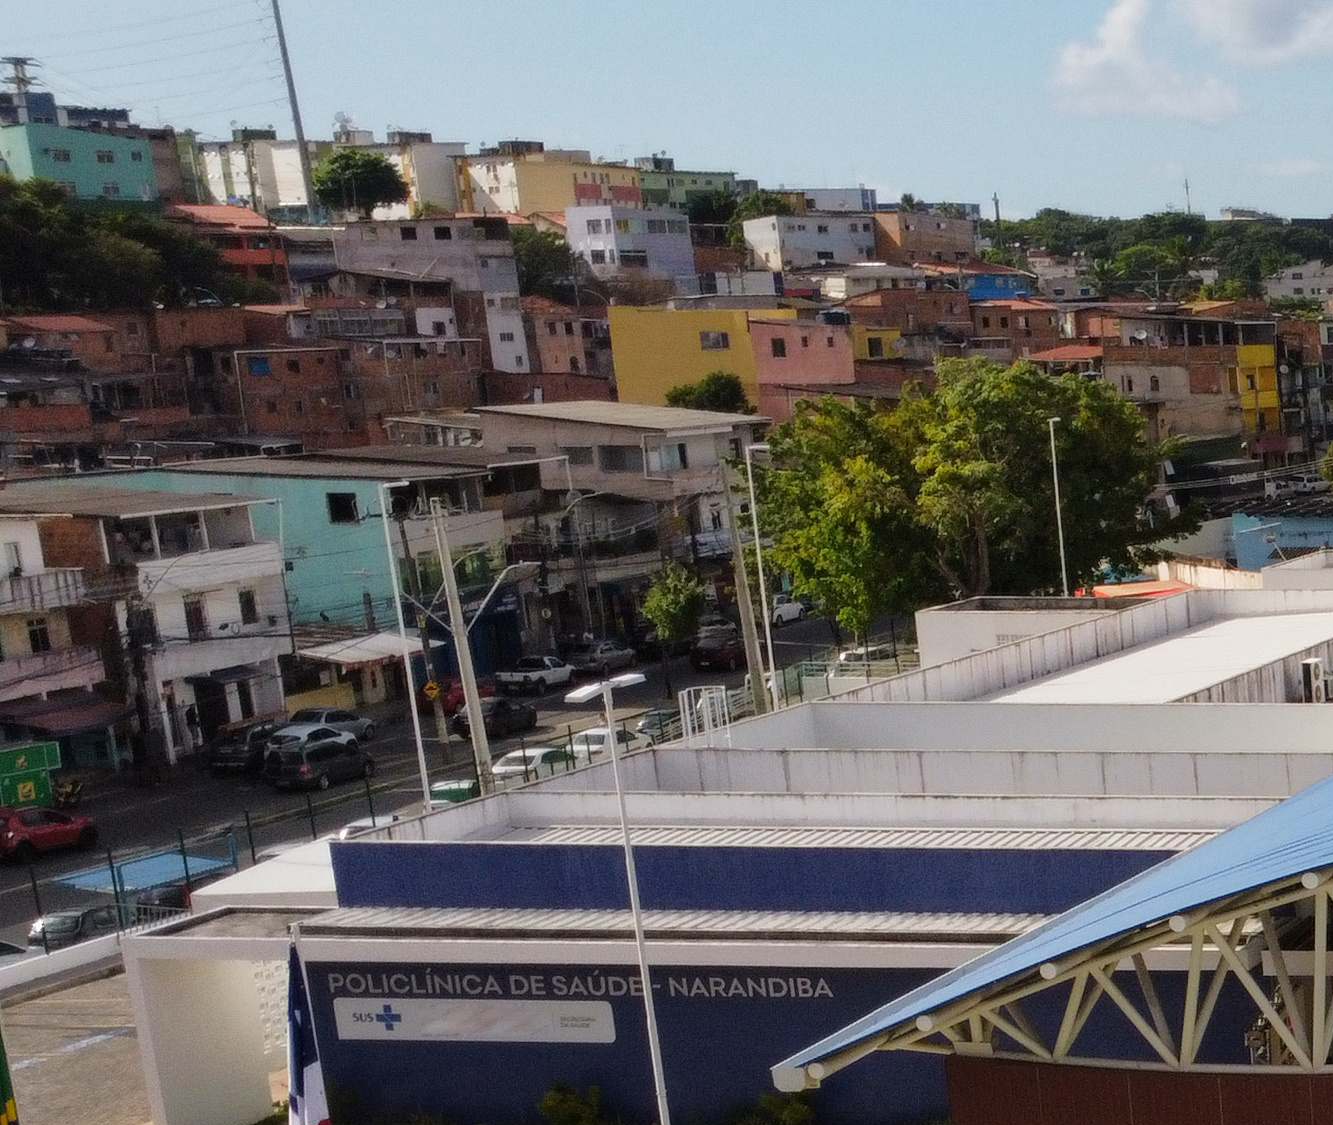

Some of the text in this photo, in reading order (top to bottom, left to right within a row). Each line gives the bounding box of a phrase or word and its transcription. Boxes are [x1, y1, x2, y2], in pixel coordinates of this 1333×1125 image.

[327, 968, 503, 995] POLICLÍNICA
[509, 975, 546, 996] DE
[552, 970, 644, 997] SAÚDE
[668, 976, 834, 999] NARANDIBA
[352, 1012, 374, 1023] SUS
